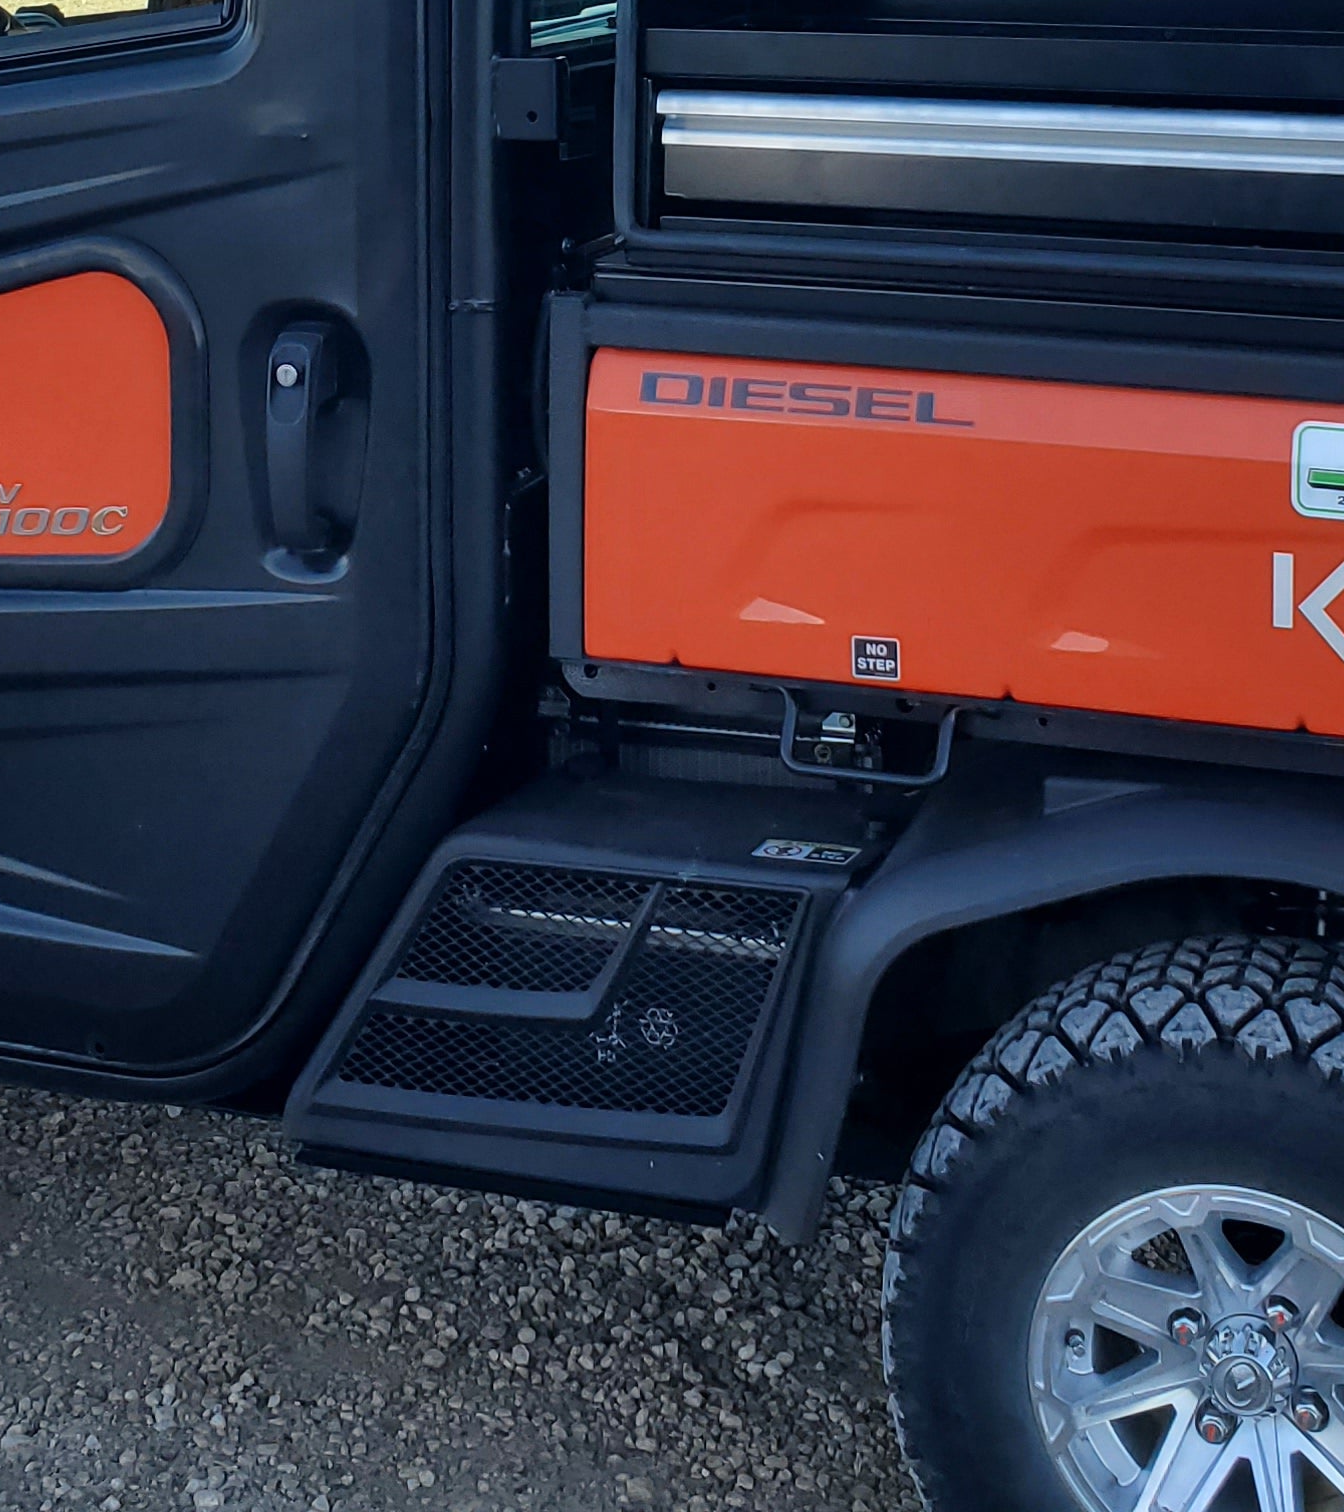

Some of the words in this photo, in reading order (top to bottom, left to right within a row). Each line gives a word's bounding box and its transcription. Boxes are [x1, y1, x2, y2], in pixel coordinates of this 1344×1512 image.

[640, 371, 975, 427] DIESEL
[866, 643, 887, 656] NO
[857, 657, 896, 672] STEP
